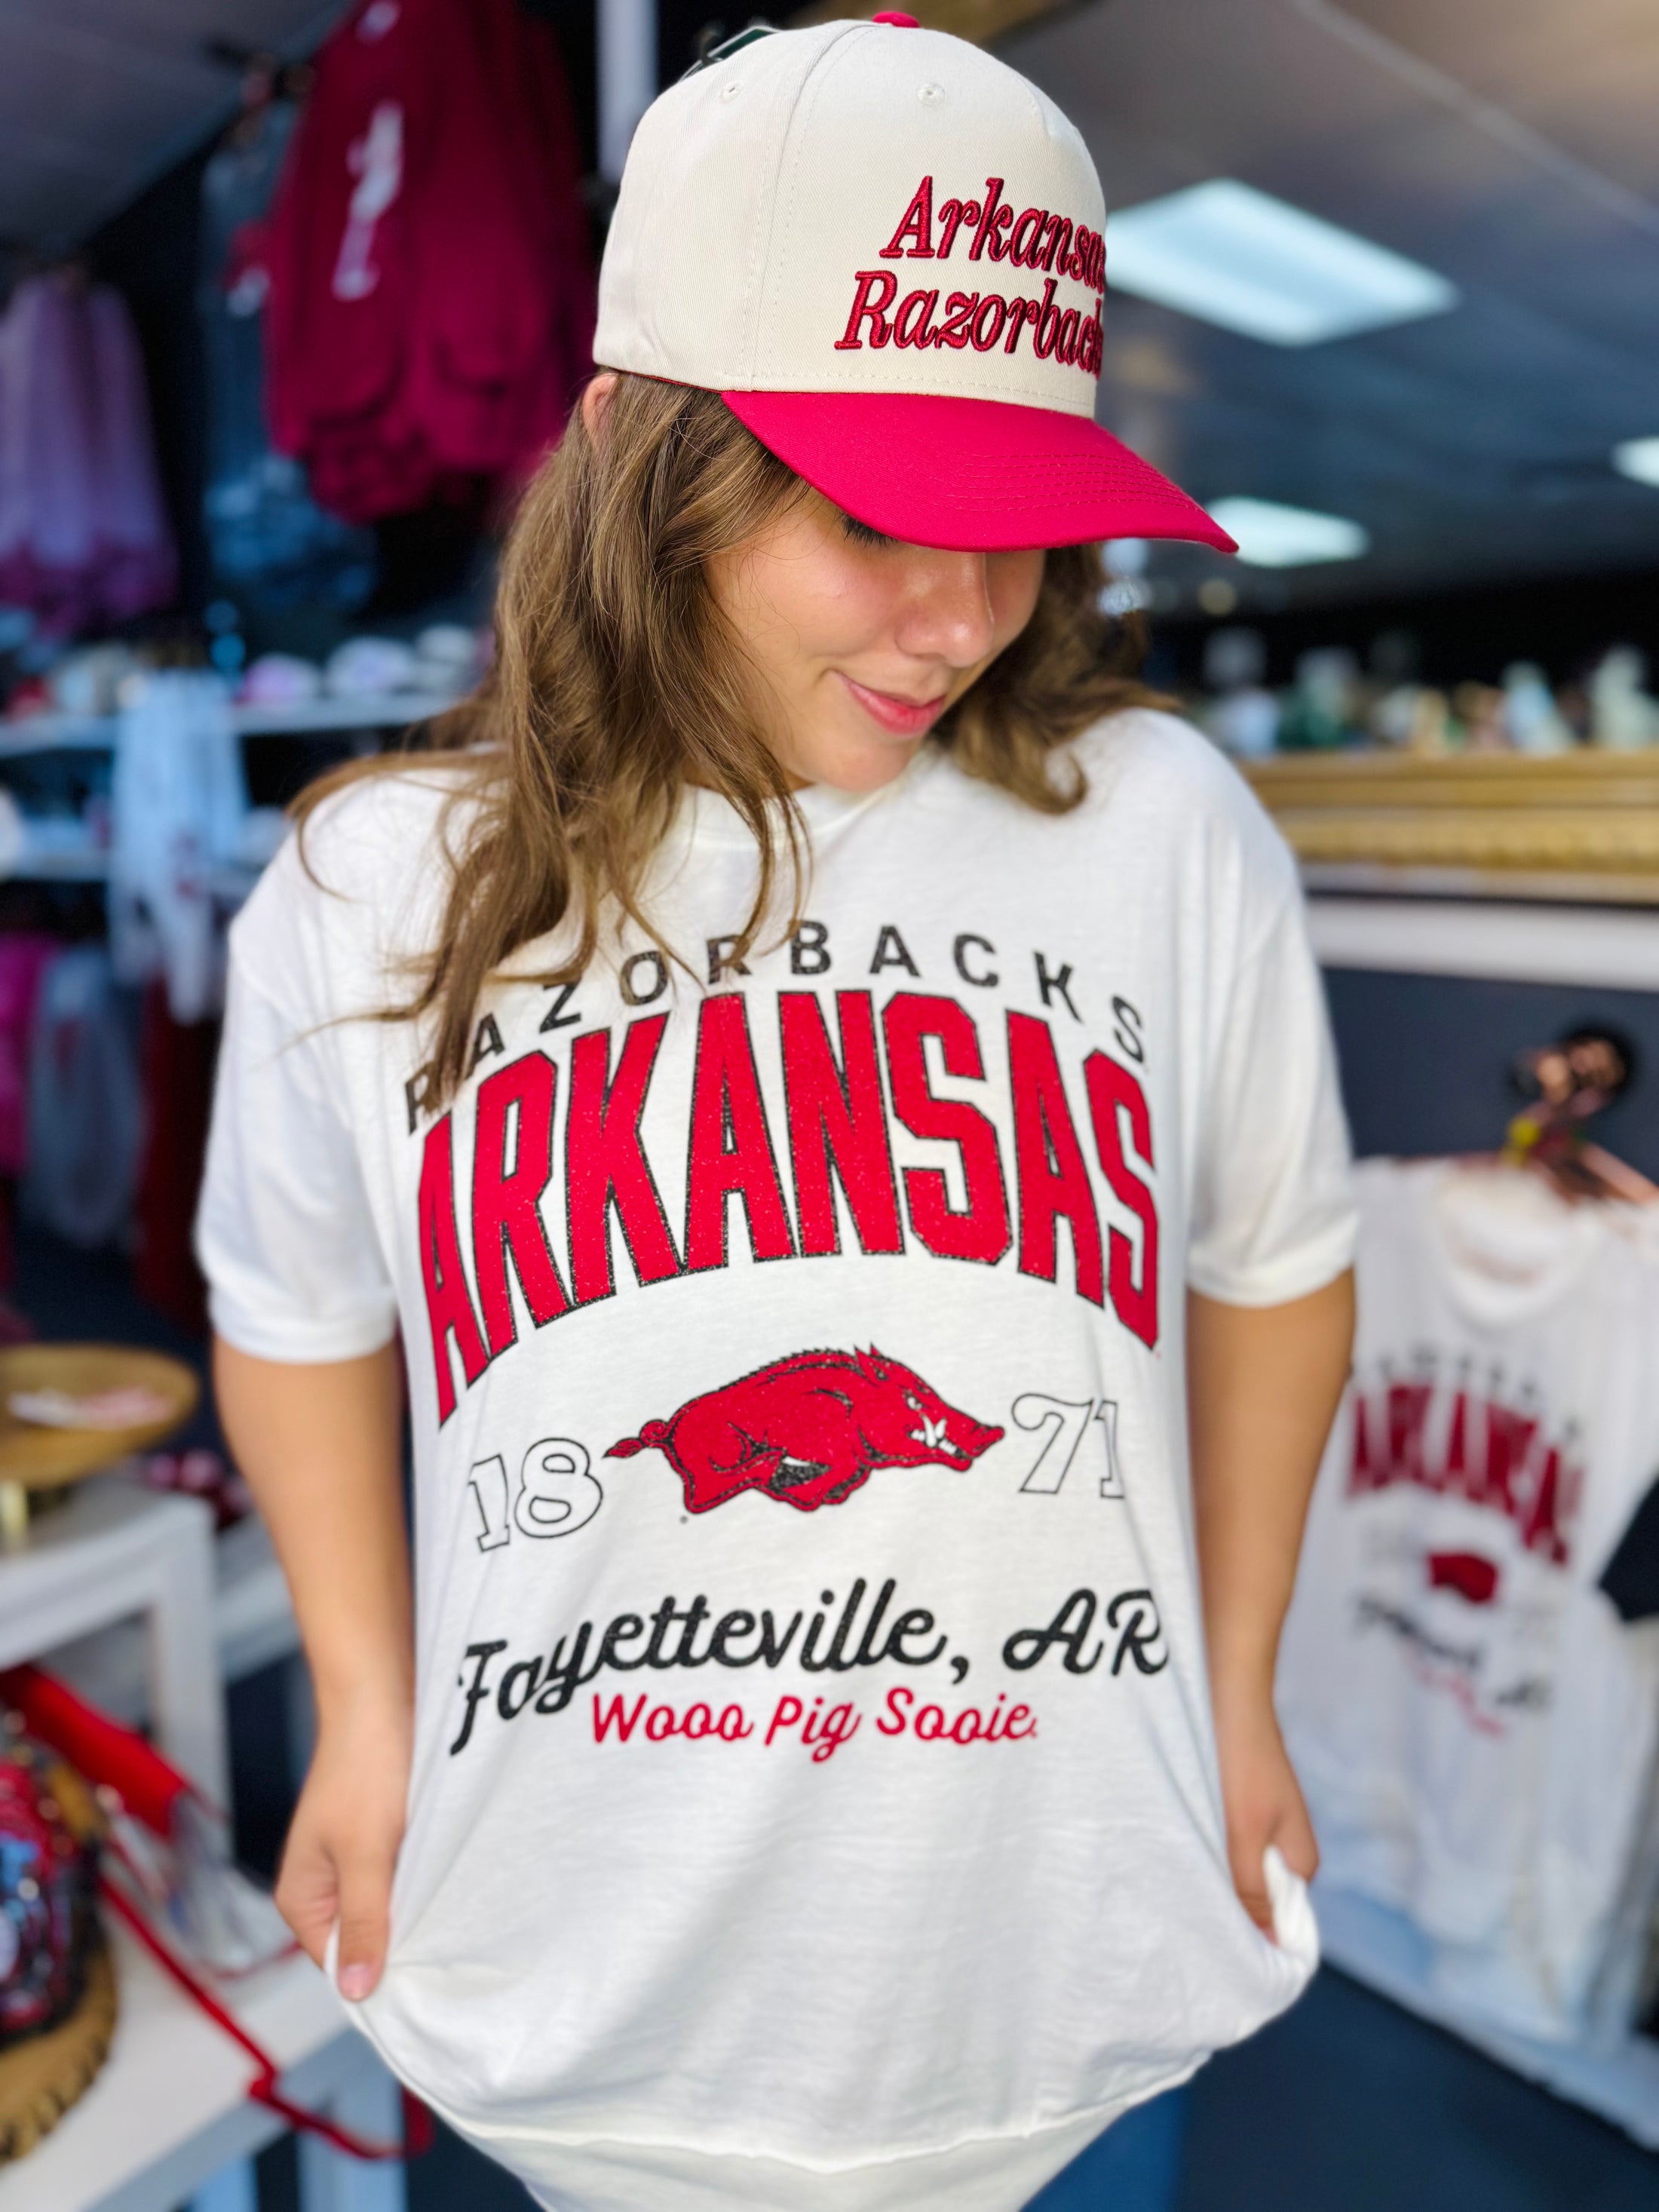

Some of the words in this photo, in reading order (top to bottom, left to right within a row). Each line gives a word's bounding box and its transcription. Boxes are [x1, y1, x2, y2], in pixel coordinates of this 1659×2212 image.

[418, 987, 1160, 1430] ARKANSAS
[468, 1436, 603, 1554] 18
[1010, 1392, 1126, 1500] 71
[448, 1576, 970, 1756] Fayetteville,
[1001, 1588, 1170, 1677] AR
[590, 1692, 755, 1744] Wooo
[763, 1694, 863, 1764] Pig
[875, 1686, 1038, 1746] Sooie
